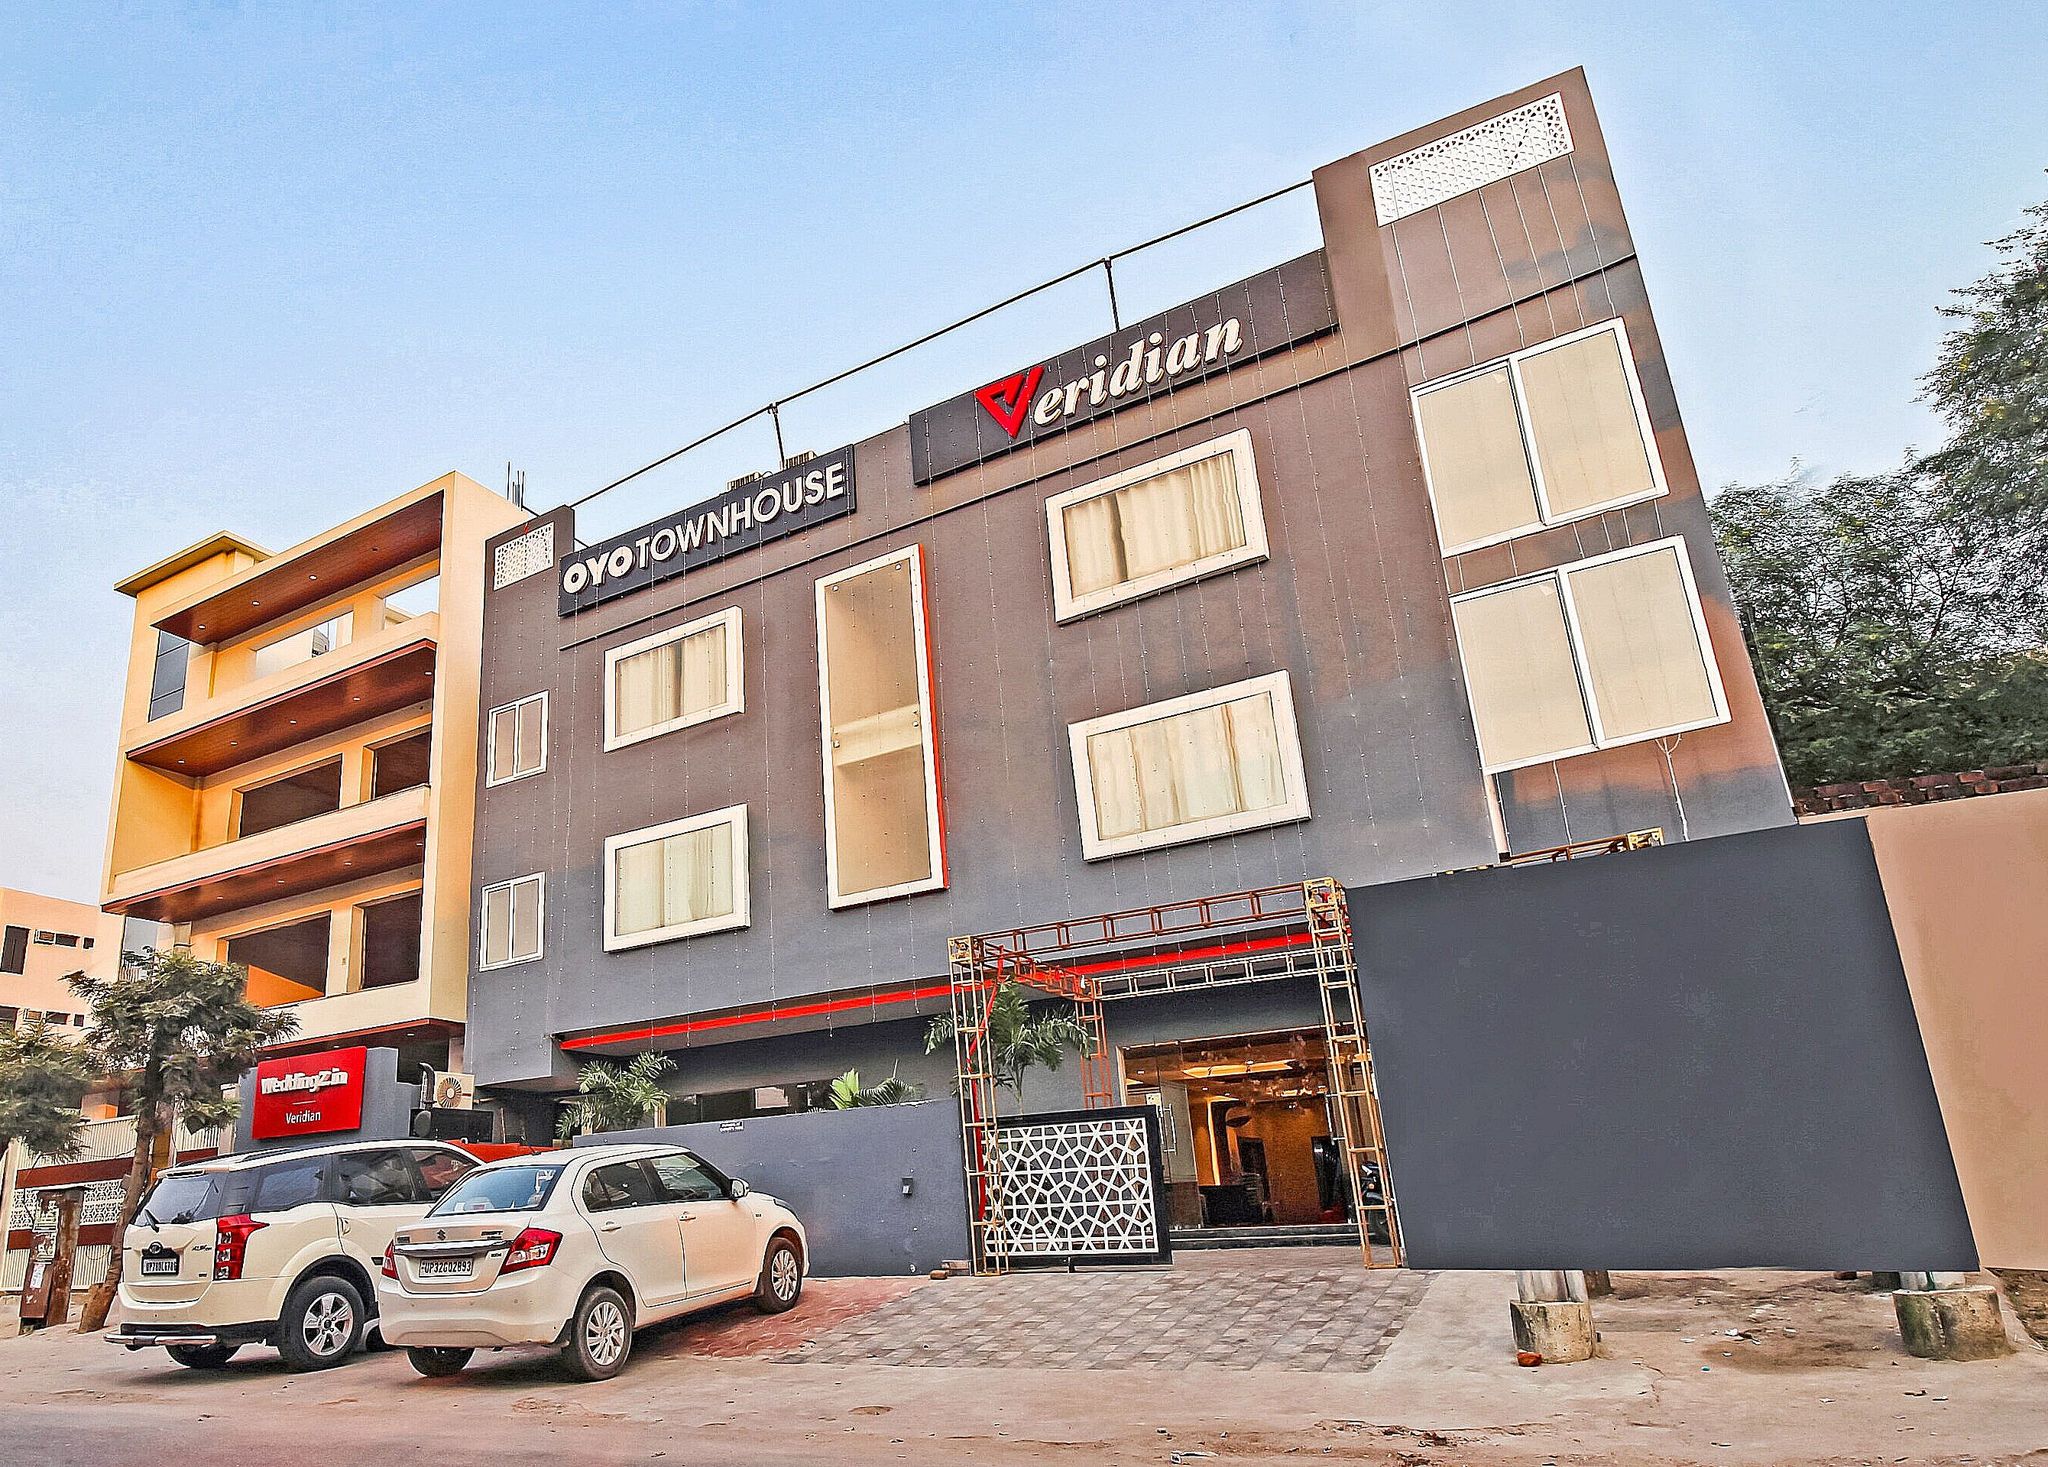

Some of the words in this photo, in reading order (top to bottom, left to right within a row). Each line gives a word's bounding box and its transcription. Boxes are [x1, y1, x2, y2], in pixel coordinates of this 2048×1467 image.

[975, 317, 1244, 439] Veridian
[562, 546, 635, 595] OYO
[636, 461, 846, 569] TOWNHOUSE
[285, 1109, 322, 1125] Veridian
